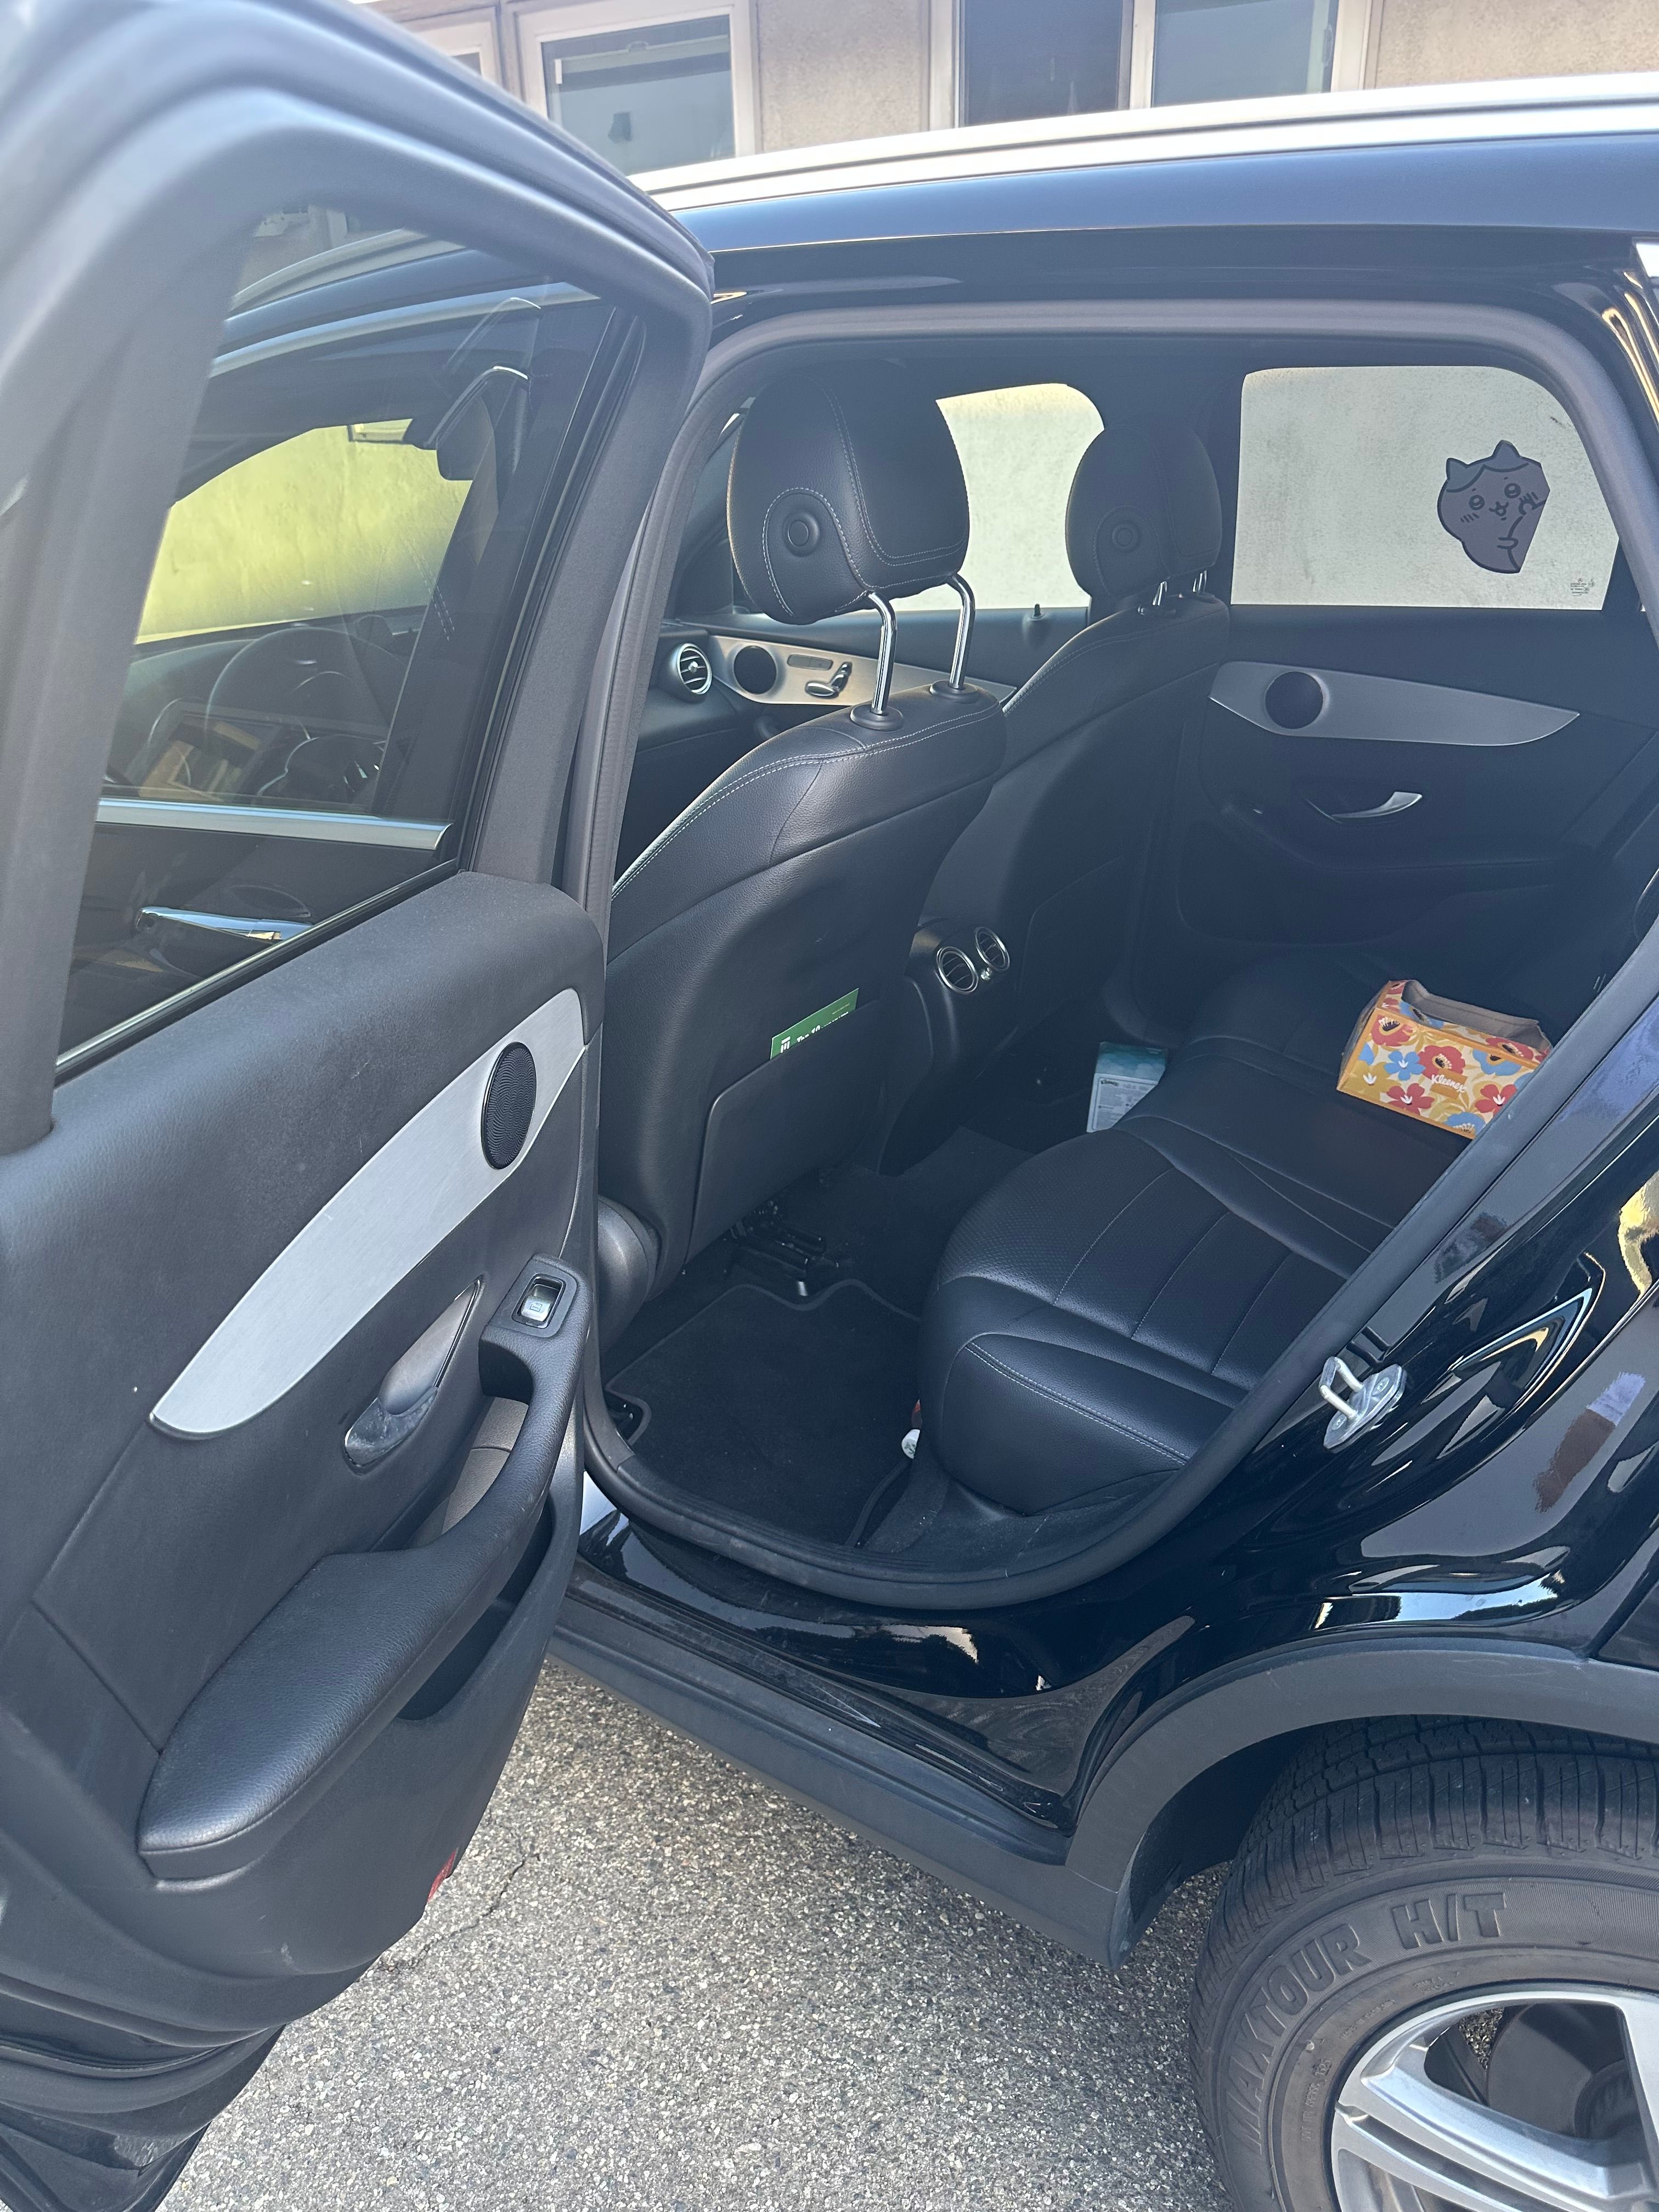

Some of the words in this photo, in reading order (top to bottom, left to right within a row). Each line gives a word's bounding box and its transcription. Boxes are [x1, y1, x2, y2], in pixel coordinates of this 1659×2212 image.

[1431, 1074, 1466, 1093] Kleenex
[1226, 1924, 1371, 2155] MAXTOUR
[1392, 1893, 1506, 1949] H/T
